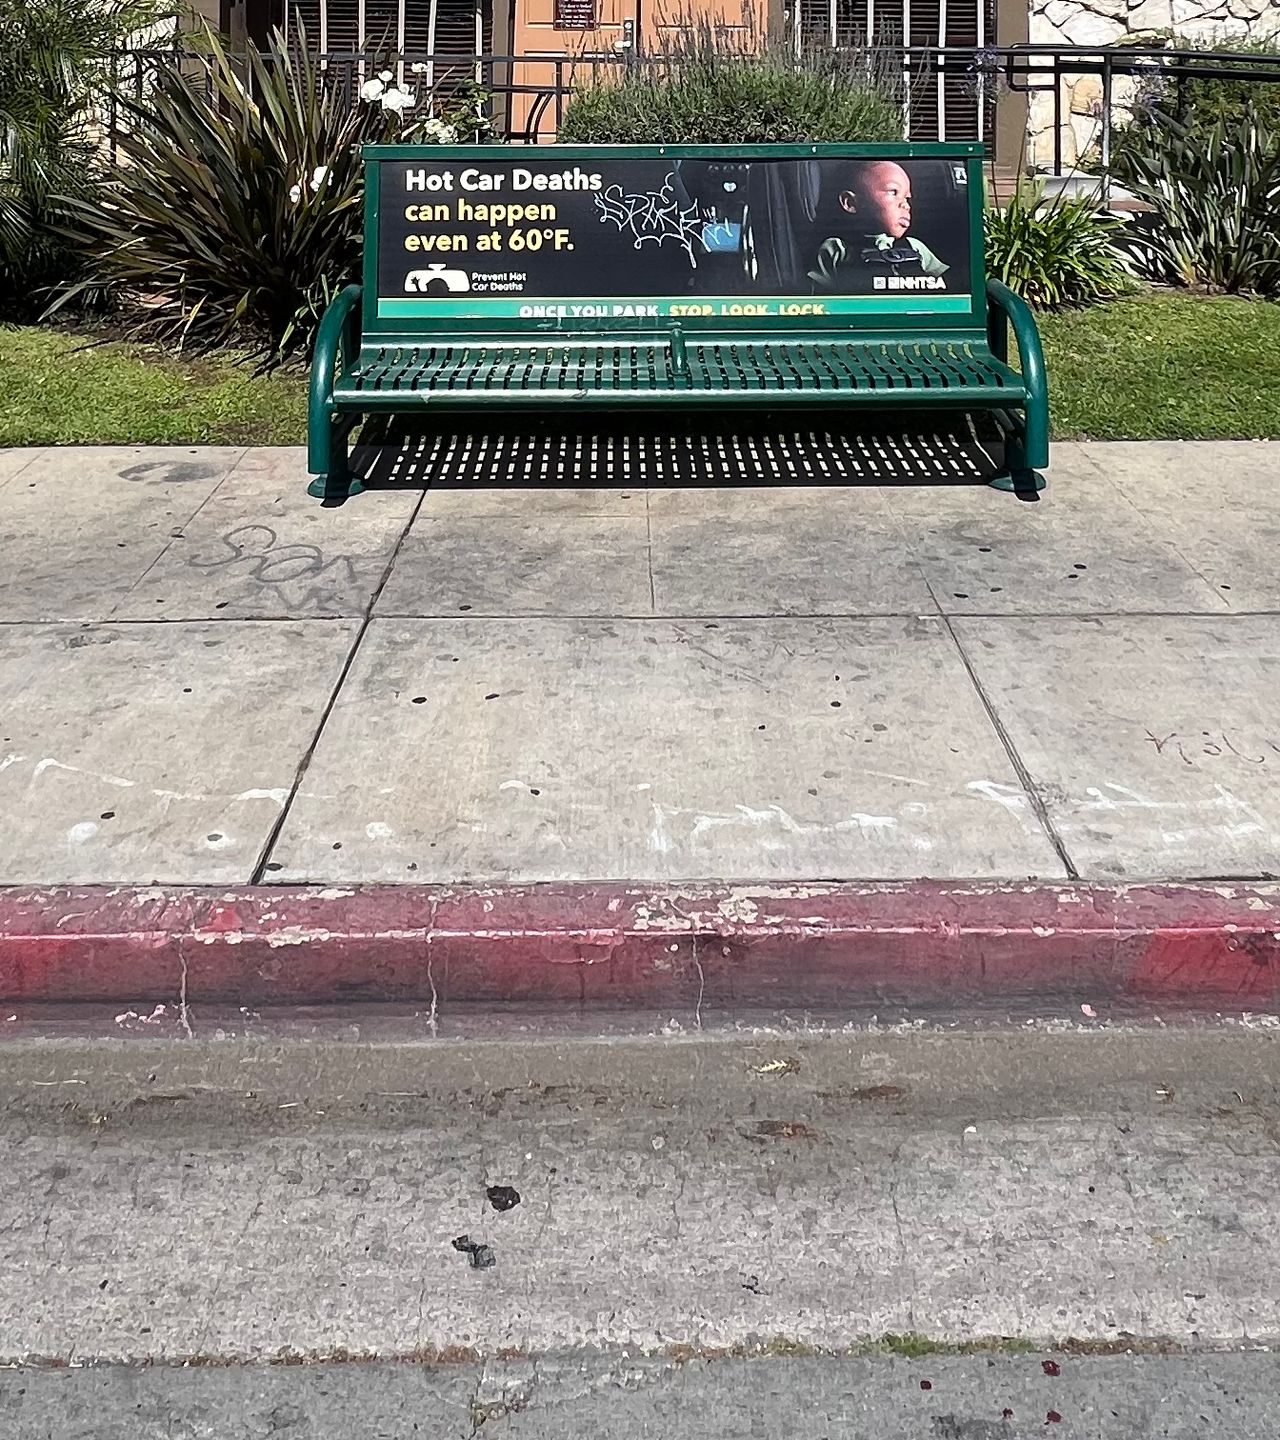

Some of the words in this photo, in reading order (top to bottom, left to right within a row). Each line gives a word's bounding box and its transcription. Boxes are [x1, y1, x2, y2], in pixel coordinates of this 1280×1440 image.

[405, 169, 454, 191] Hot
[459, 169, 505, 191] Car
[512, 167, 603, 191] Deaths
[404, 202, 450, 222] can
[457, 198, 557, 227] happen
[404, 232, 468, 252] even
[476, 229, 502, 251] at
[508, 228, 575, 251] 60°F.
[509, 272, 527, 281] Hot
[899, 275, 947, 290] NHTSA
[471, 282, 489, 291] Car
[490, 281, 524, 291] Deaths
[519, 305, 567, 317] ONCE
[570, 305, 608, 317] YOU
